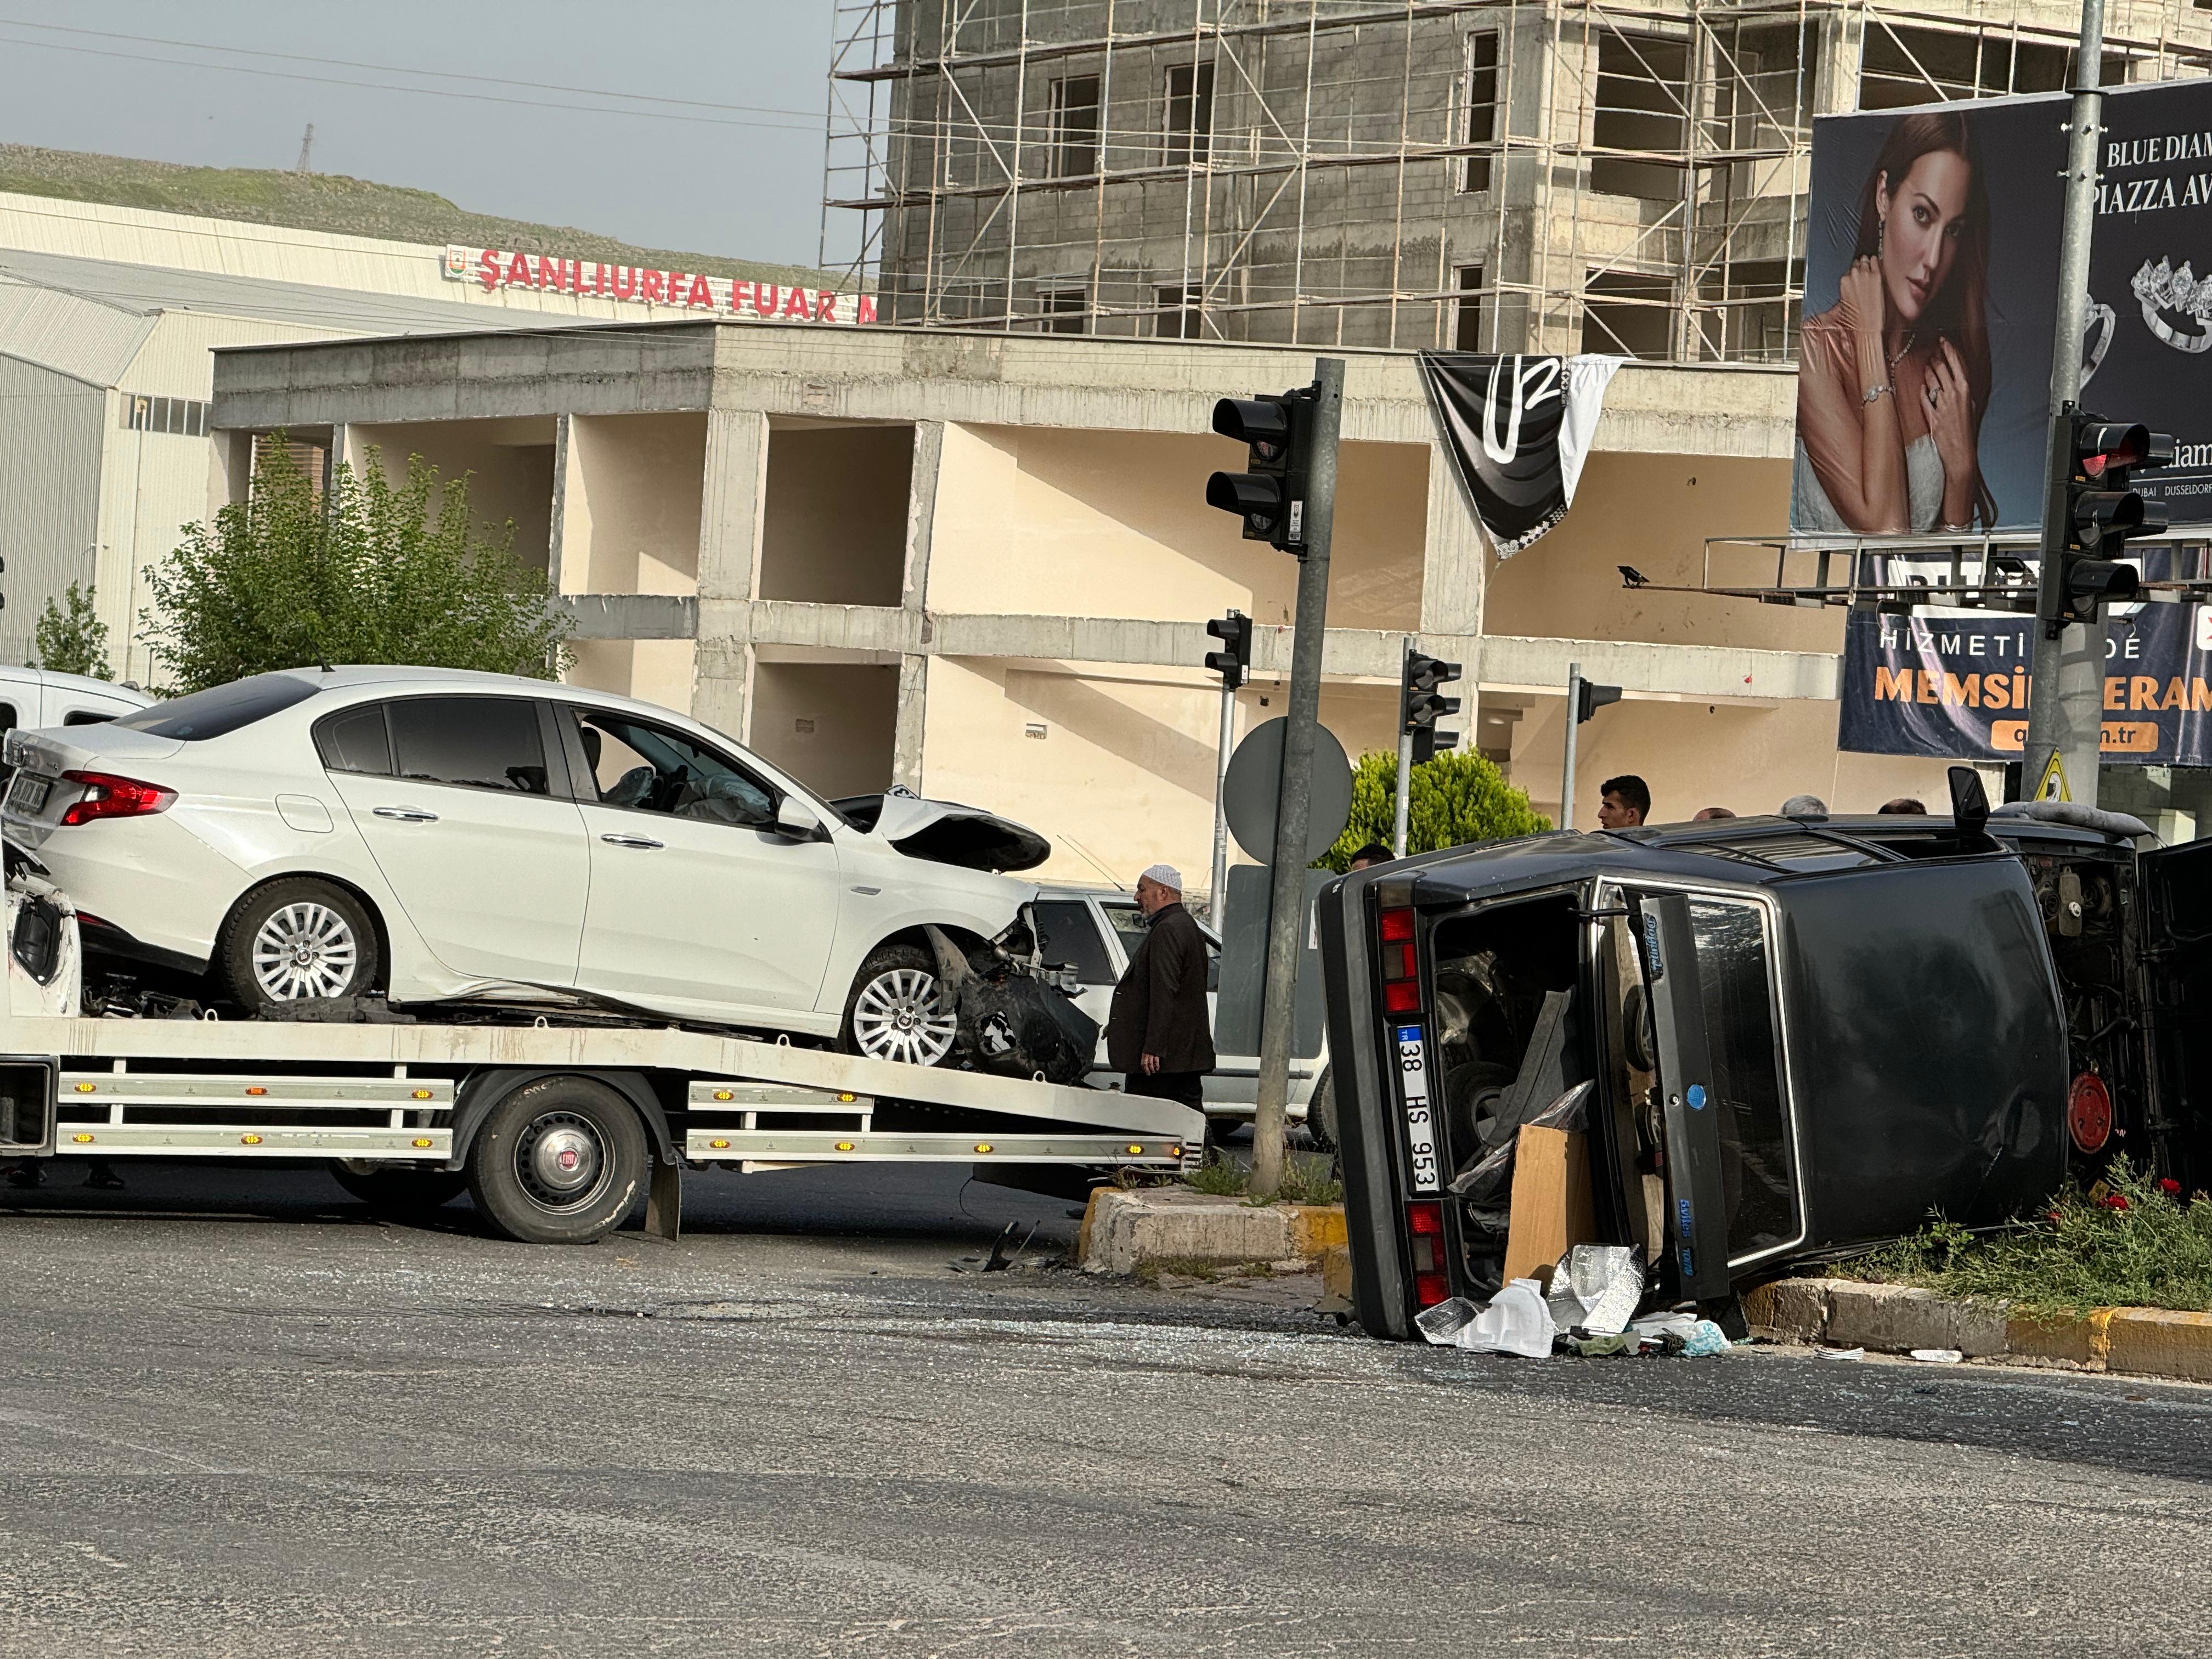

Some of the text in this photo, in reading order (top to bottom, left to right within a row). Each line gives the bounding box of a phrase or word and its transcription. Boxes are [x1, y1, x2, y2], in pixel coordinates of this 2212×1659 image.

[2106, 138, 2161, 168] BLUE
[479, 249, 714, 308] ŞANLIURFA
[732, 279, 837, 323] FUAR
[2160, 439, 2212, 469] iam
[1875, 665, 2212, 712] MEMSİ ERAM
[1401, 1030, 1408, 1041] TR
[1401, 1044, 1436, 1185] 38 HS 953
